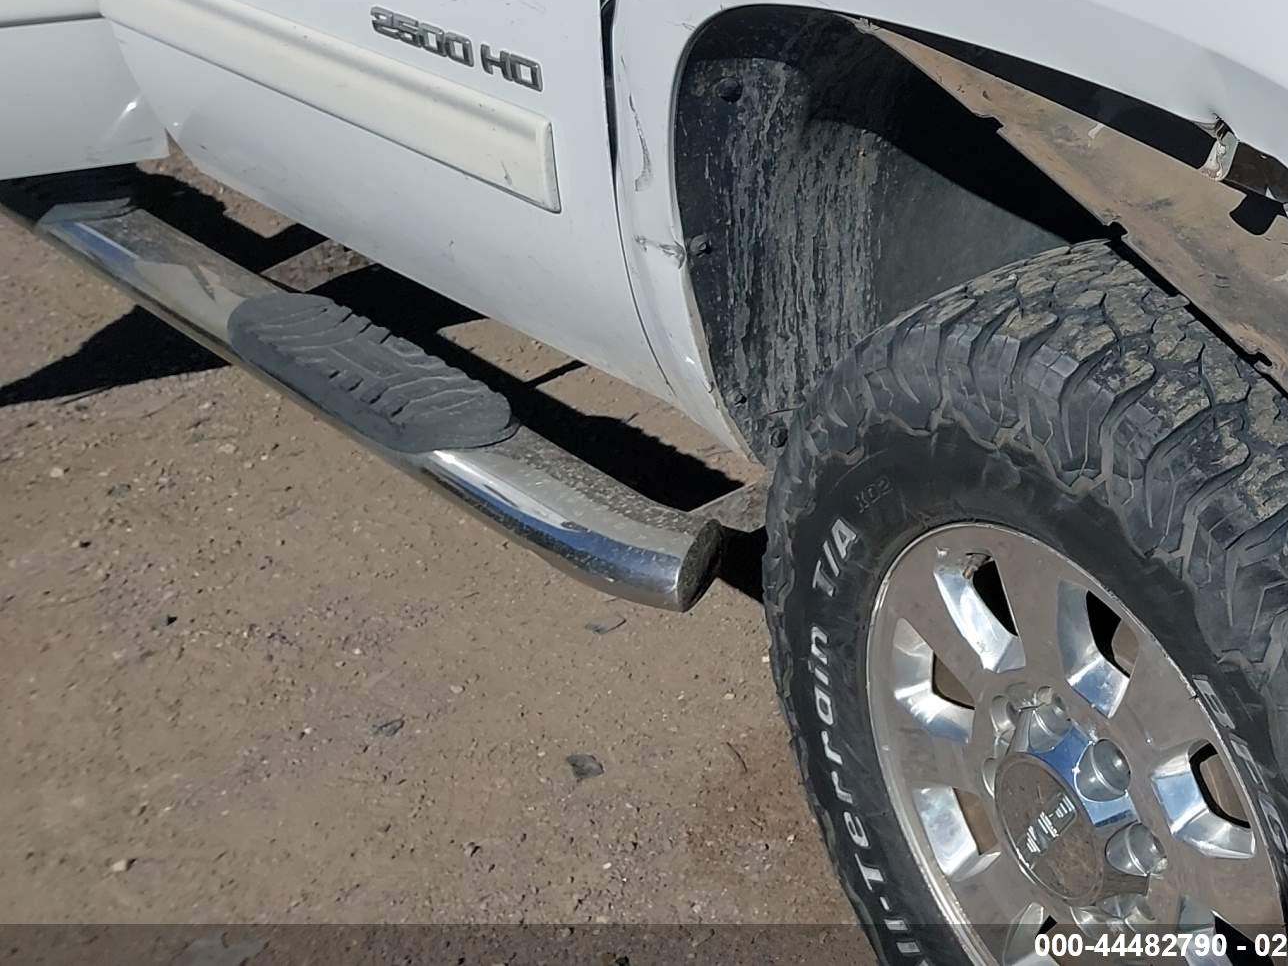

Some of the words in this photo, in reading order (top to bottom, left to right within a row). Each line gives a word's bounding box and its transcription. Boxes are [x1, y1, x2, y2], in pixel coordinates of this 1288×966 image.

[370, 5, 475, 68] 2500
[480, 42, 544, 93] HD
[811, 516, 860, 598] T/A
[808, 623, 929, 966] ll-Terrain
